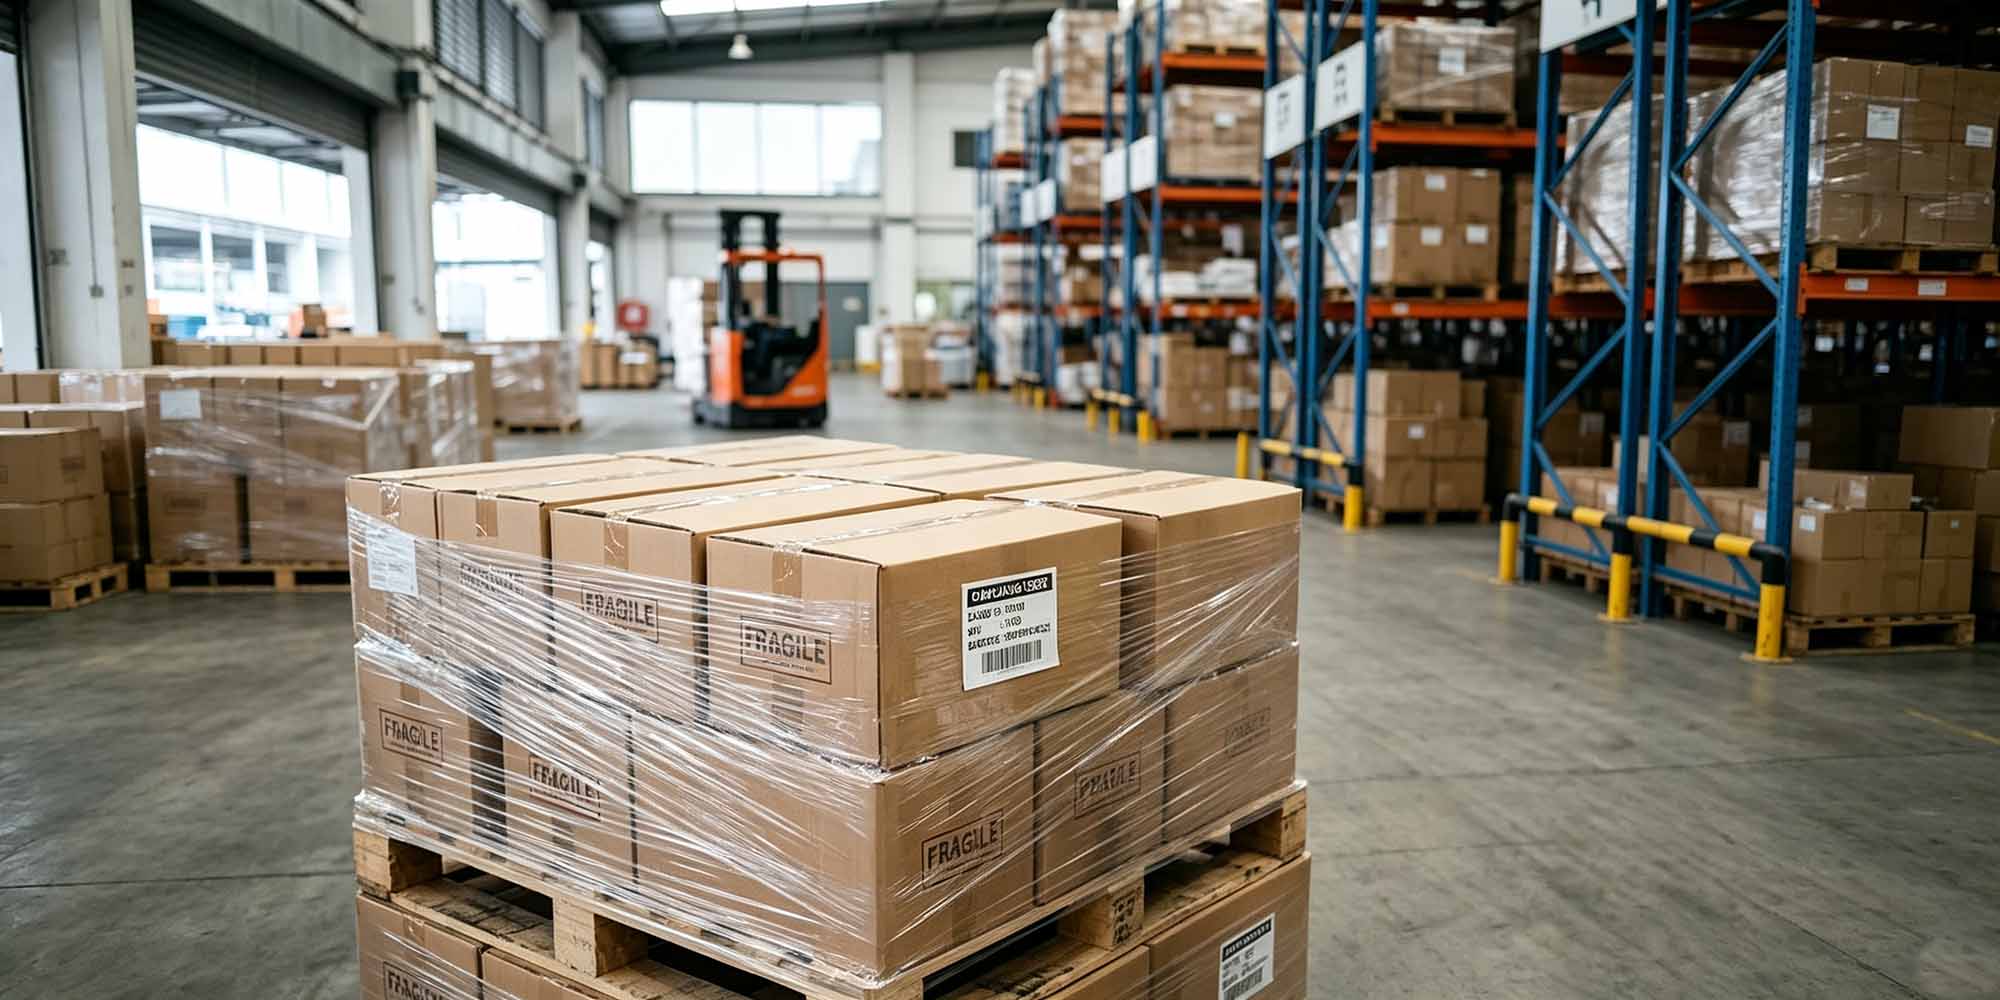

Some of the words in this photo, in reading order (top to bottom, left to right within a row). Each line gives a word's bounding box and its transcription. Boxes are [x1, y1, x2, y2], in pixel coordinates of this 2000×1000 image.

[584, 593, 655, 627] FRAGILE
[744, 625, 826, 665] FRAGILE
[384, 717, 439, 752] FRAGILE
[927, 819, 999, 870] FRAGILE
[388, 970, 445, 1000] FRAGI
